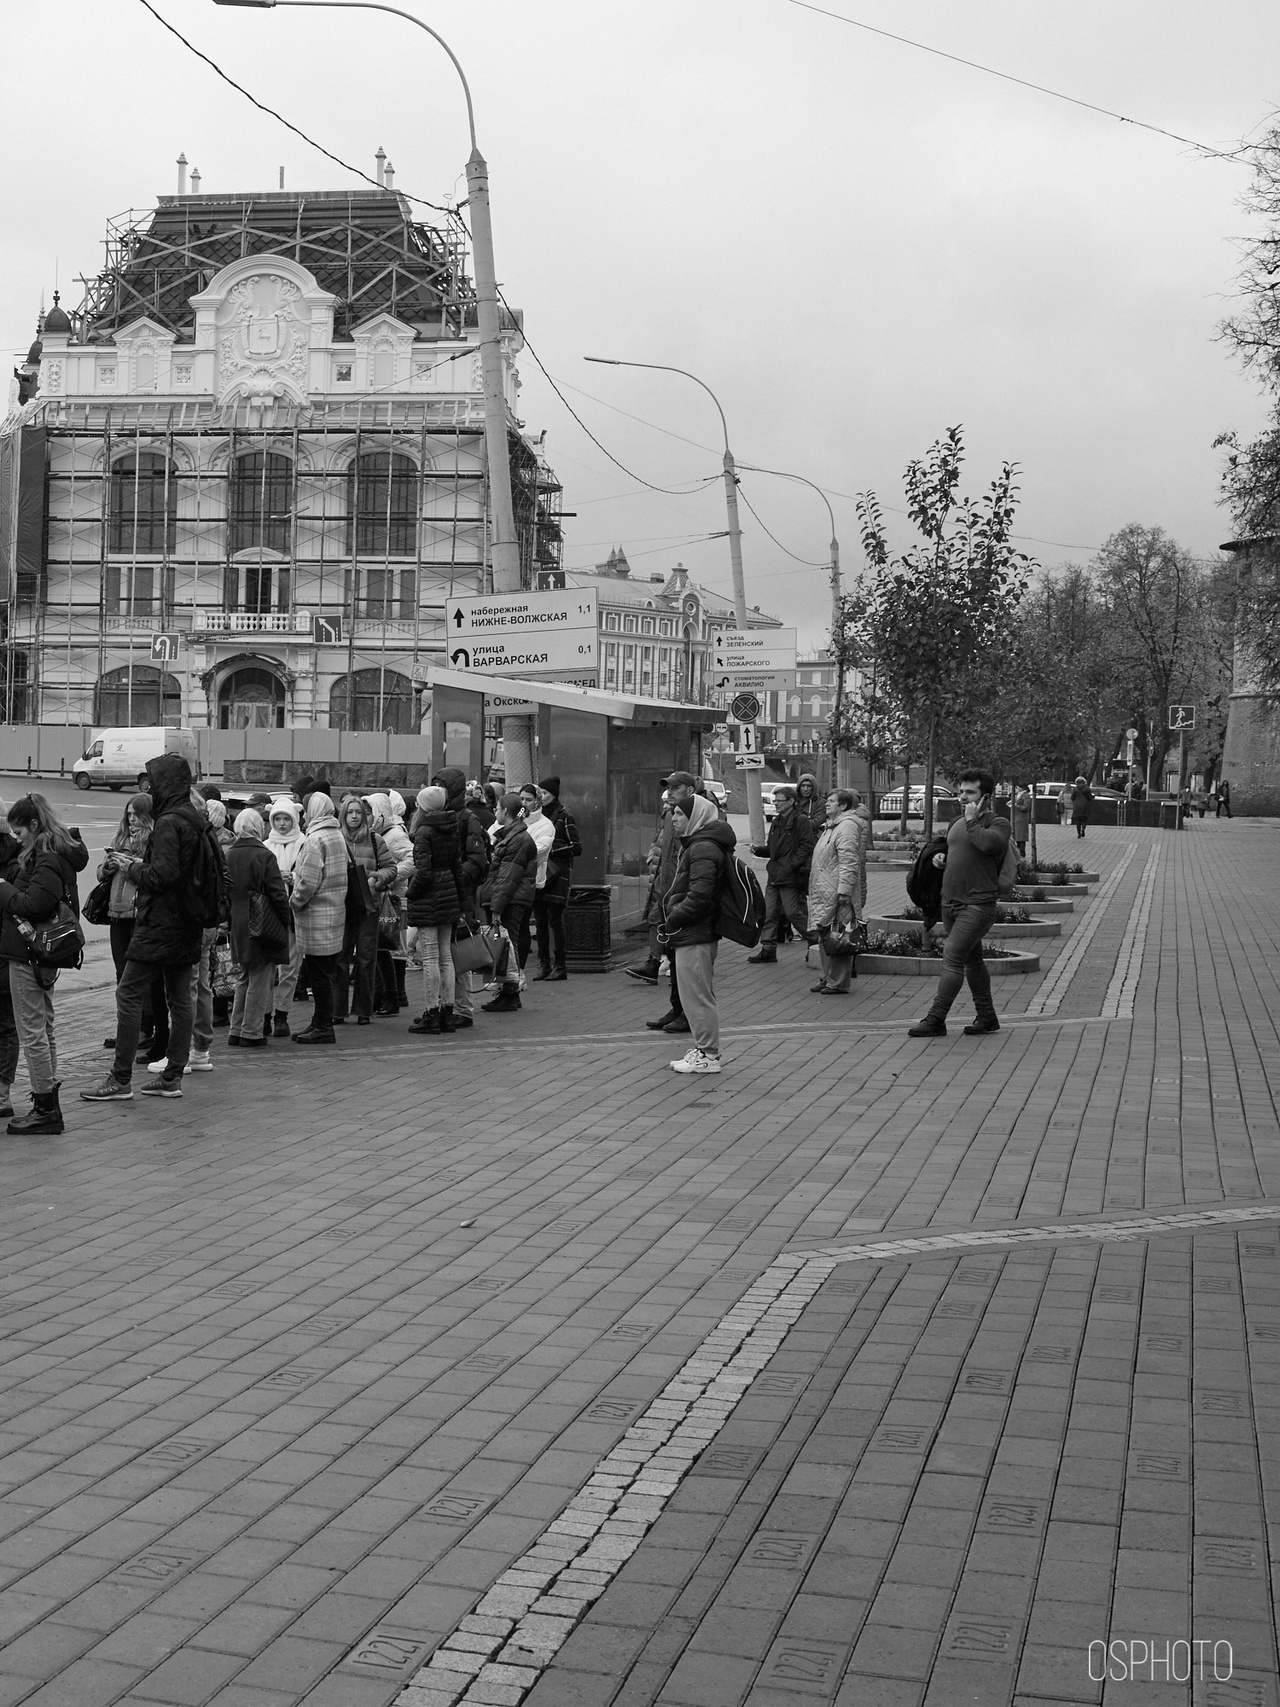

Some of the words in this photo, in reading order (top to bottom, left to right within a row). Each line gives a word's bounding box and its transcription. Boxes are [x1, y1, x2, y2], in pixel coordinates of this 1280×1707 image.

[471, 604, 528, 616] набережная
[577, 604, 591, 614] 1,1
[471, 612, 567, 627] НИЖНЕ-ВОЛЖСКАЯ
[472, 645, 505, 656] улица
[578, 645, 591, 654] 0,1
[473, 653, 548, 667] ВАРВАРСКАЯ
[493, 696, 533, 706] Окско
[610, 1323, 654, 1339] 1221
[1029, 1345, 1072, 1361] 1221
[1147, 1337, 1183, 1353] 1221
[265, 1370, 317, 1388] 1221
[756, 1375, 802, 1392] 1221
[965, 1373, 1007, 1390] 1221
[587, 1401, 638, 1420] 1221
[1201, 1393, 1242, 1412] 1221
[878, 1430, 925, 1448] 1221
[145, 1441, 208, 1463] 1221
[702, 1450, 754, 1472] 1221
[1136, 1455, 1181, 1476] 1221
[424, 1494, 485, 1520] 1221
[986, 1502, 1039, 1529] 1221
[751, 1537, 809, 1562] 1221
[1204, 1542, 1256, 1571] 1221
[119, 1552, 192, 1581] 1221
[950, 1621, 1012, 1654] 1221
[352, 1634, 427, 1670] 1221
[770, 1647, 836, 1683] 1221
